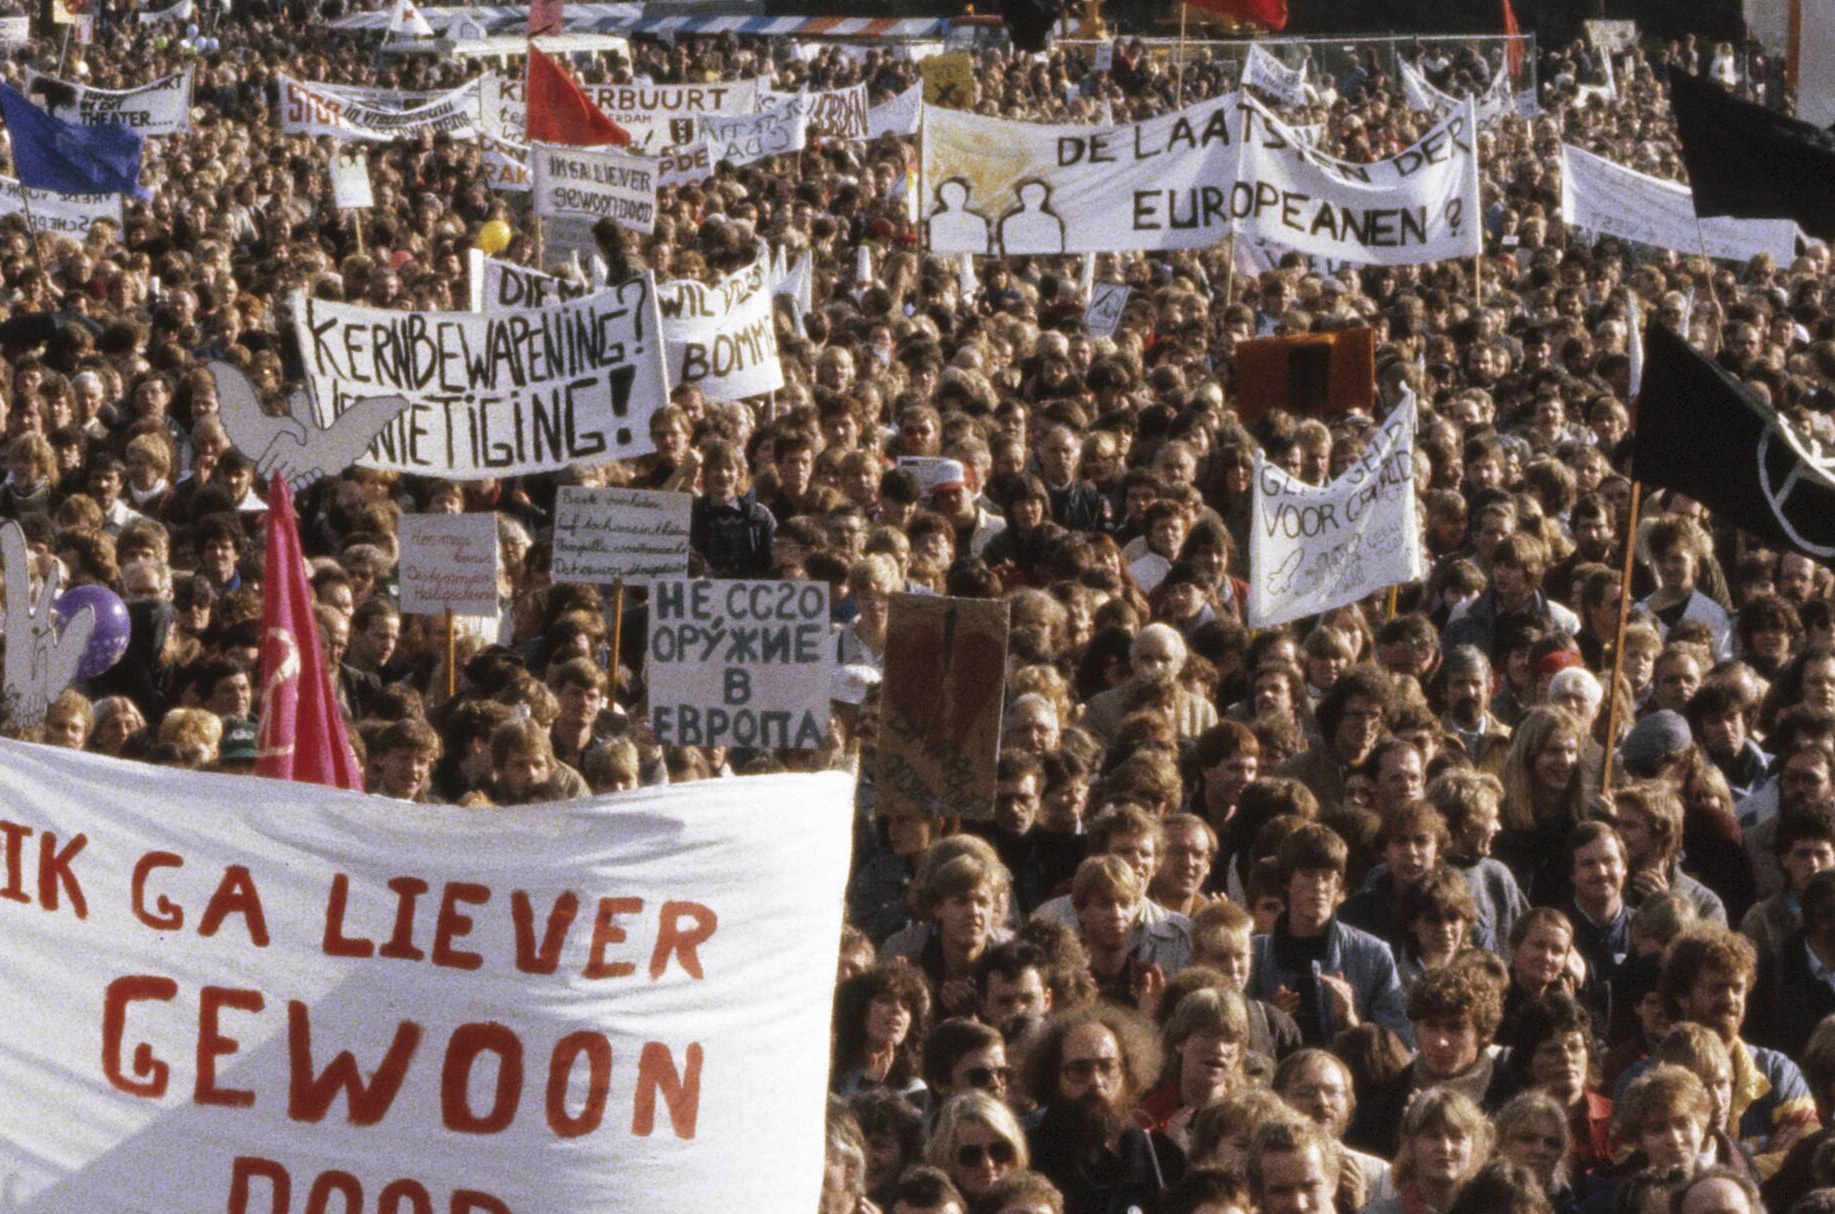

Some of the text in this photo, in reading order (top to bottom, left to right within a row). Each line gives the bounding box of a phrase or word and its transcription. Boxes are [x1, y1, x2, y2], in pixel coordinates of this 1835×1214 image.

[499, 81, 728, 111] KIRBUURT
[1058, 134, 1117, 168] DE
[1393, 116, 1472, 176] DER
[594, 161, 652, 193] LIEVER
[1134, 181, 1428, 247] EUROPEANEN
[306, 277, 647, 394] KERNBEWAPENING?
[682, 316, 780, 383] BOMM
[1262, 503, 1341, 540] VOOR
[657, 580, 712, 620] НЕ
[724, 667, 752, 706] В
[653, 703, 825, 749] ЕВРОПА
[130, 850, 270, 949] GA
[321, 872, 719, 984] LIEVER
[102, 974, 706, 1141] GEWOON
